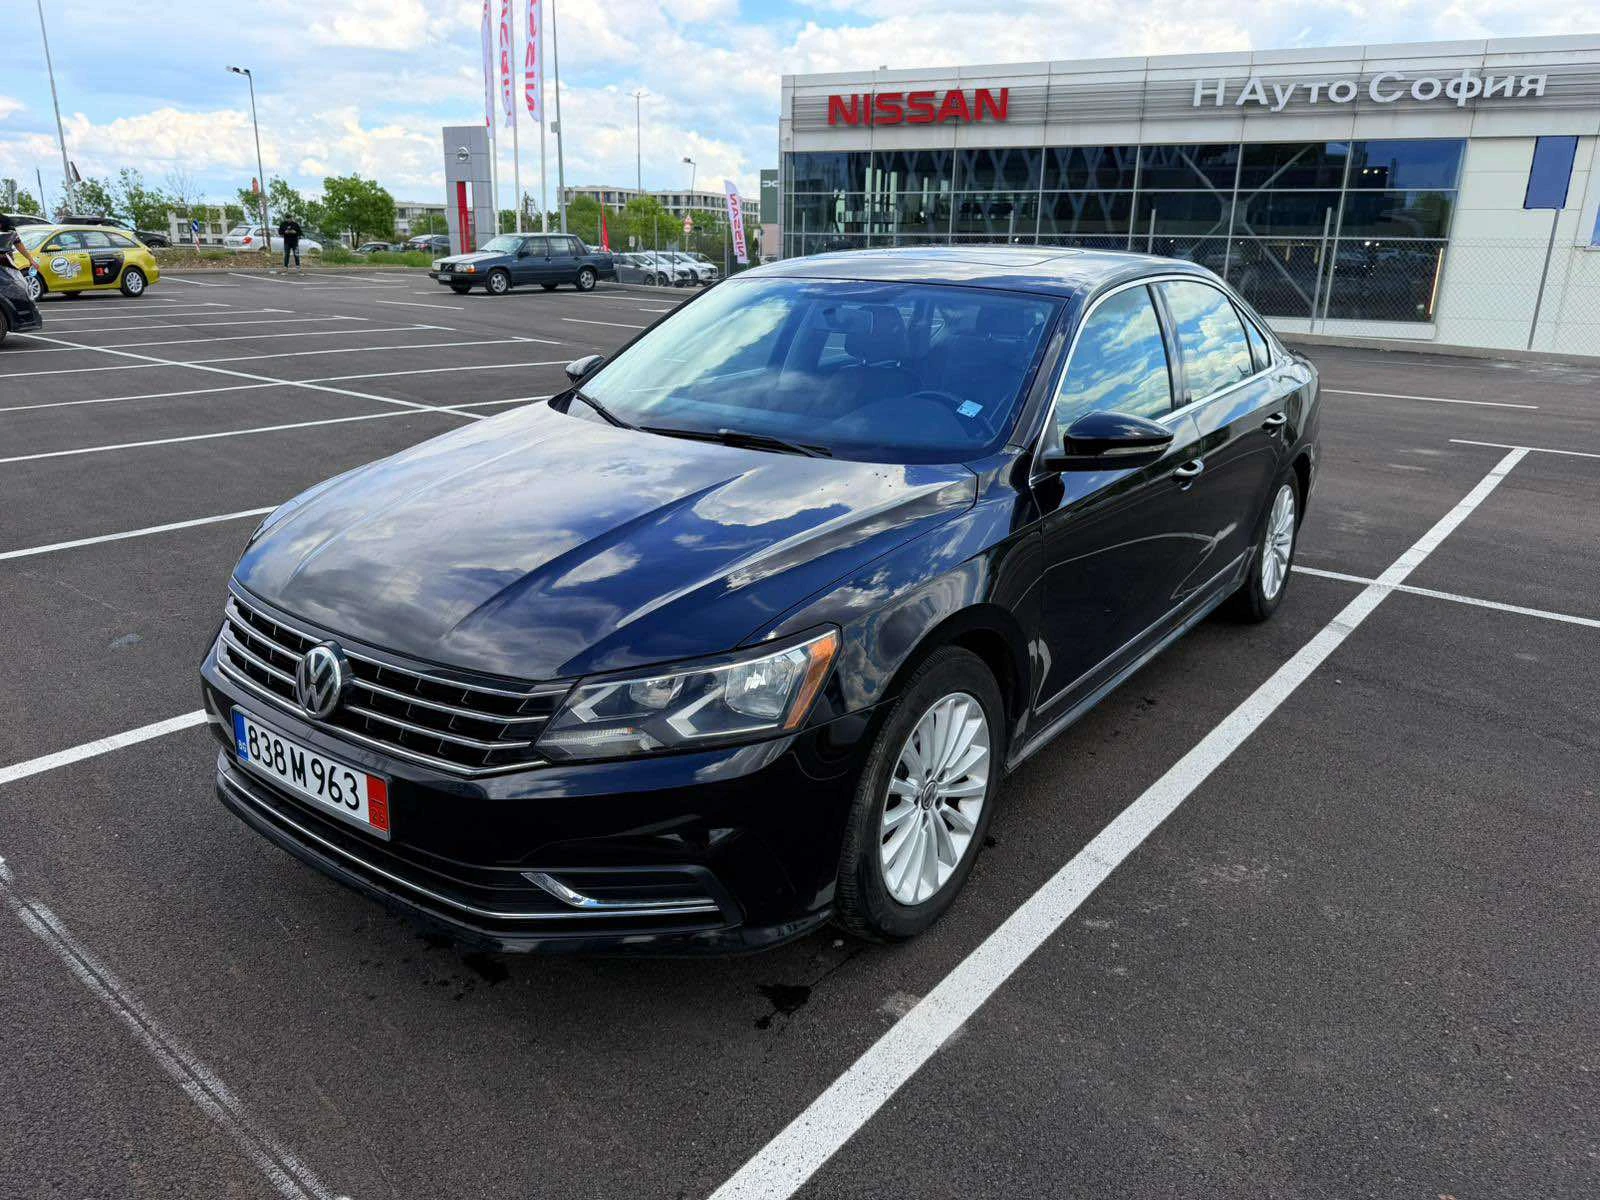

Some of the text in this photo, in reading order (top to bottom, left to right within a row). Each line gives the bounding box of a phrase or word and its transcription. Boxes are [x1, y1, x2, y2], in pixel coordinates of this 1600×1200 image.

[827, 87, 1009, 126] NISSAN
[1235, 76, 1359, 113] Ауто
[1368, 69, 1548, 107] София
[248, 725, 286, 775] 838
[310, 757, 360, 811] 963
